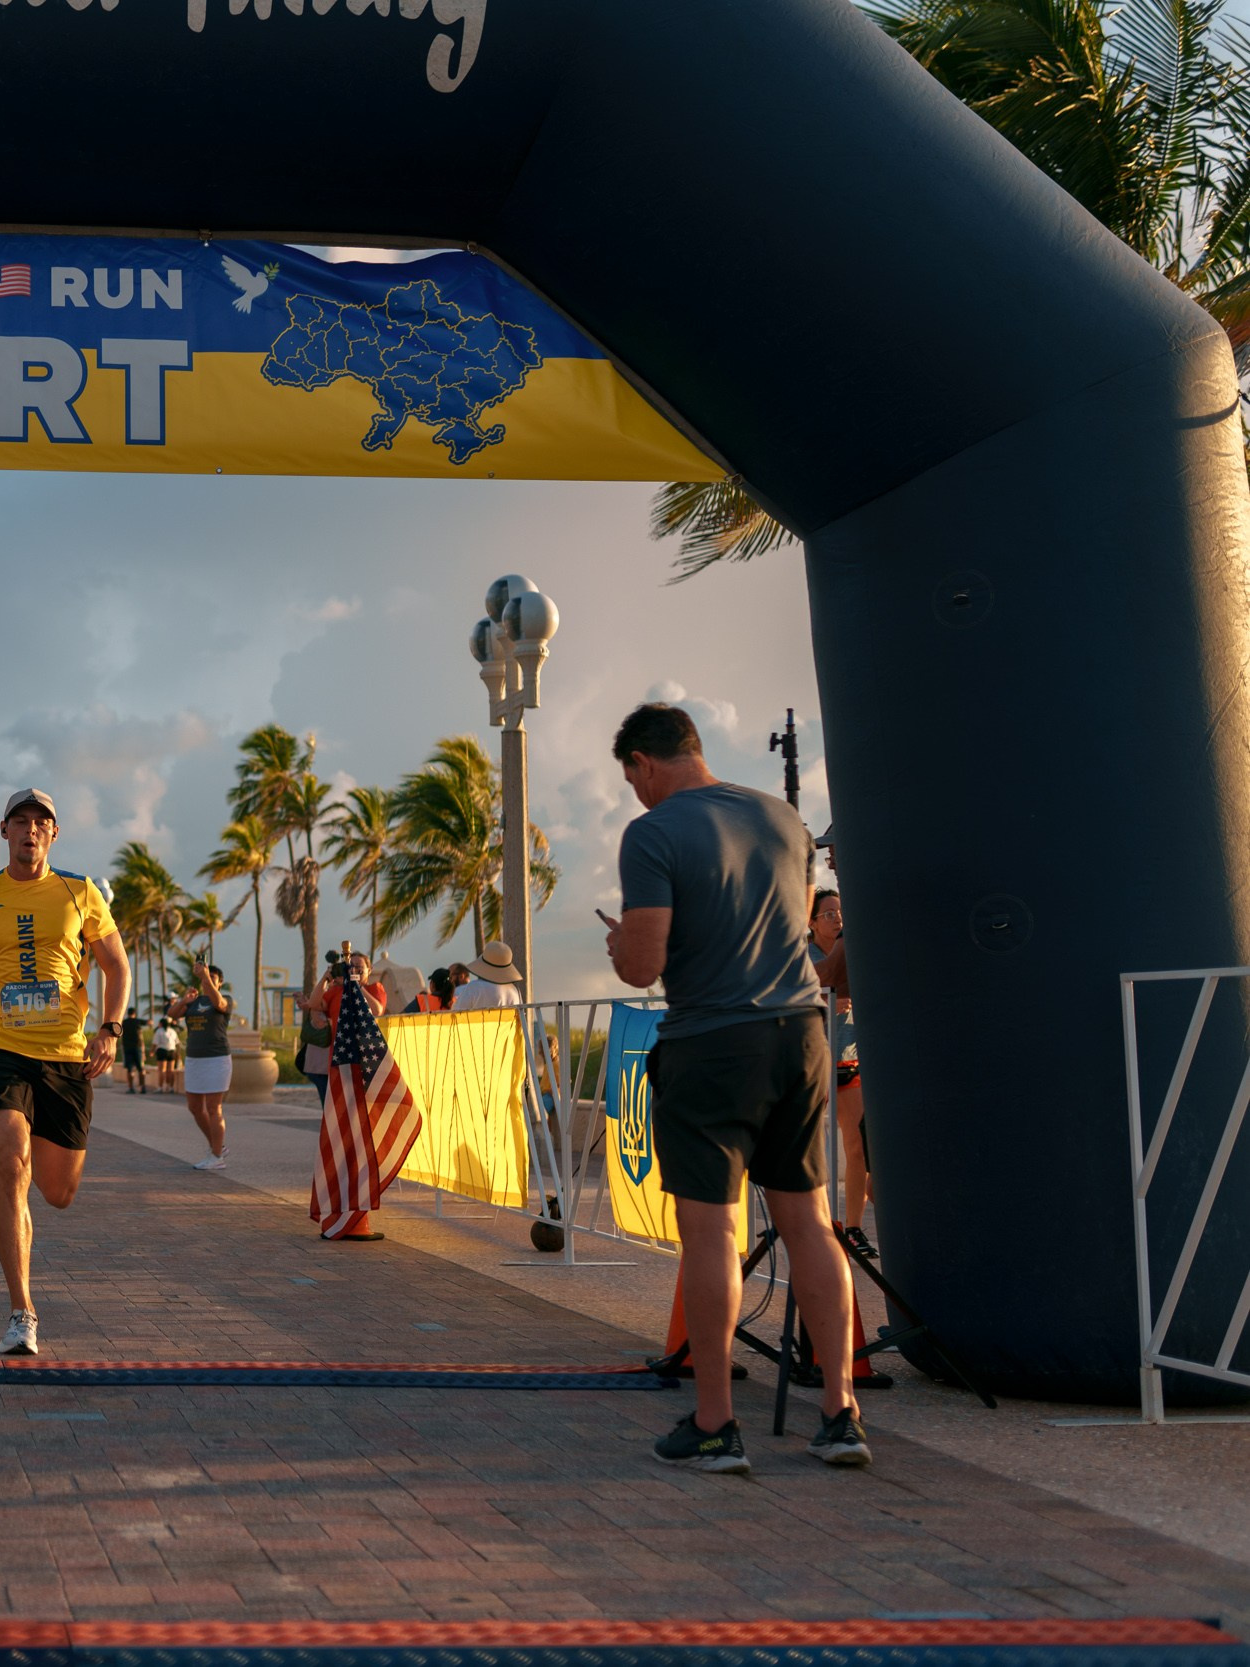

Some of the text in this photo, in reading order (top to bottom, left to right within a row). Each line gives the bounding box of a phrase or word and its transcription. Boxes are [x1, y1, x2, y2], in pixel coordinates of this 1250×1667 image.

[50, 266, 183, 309] RUN
[17, 914, 38, 983] UKRAINE
[15, 992, 46, 1012] 176
[699, 1438, 725, 1452] HOKA
